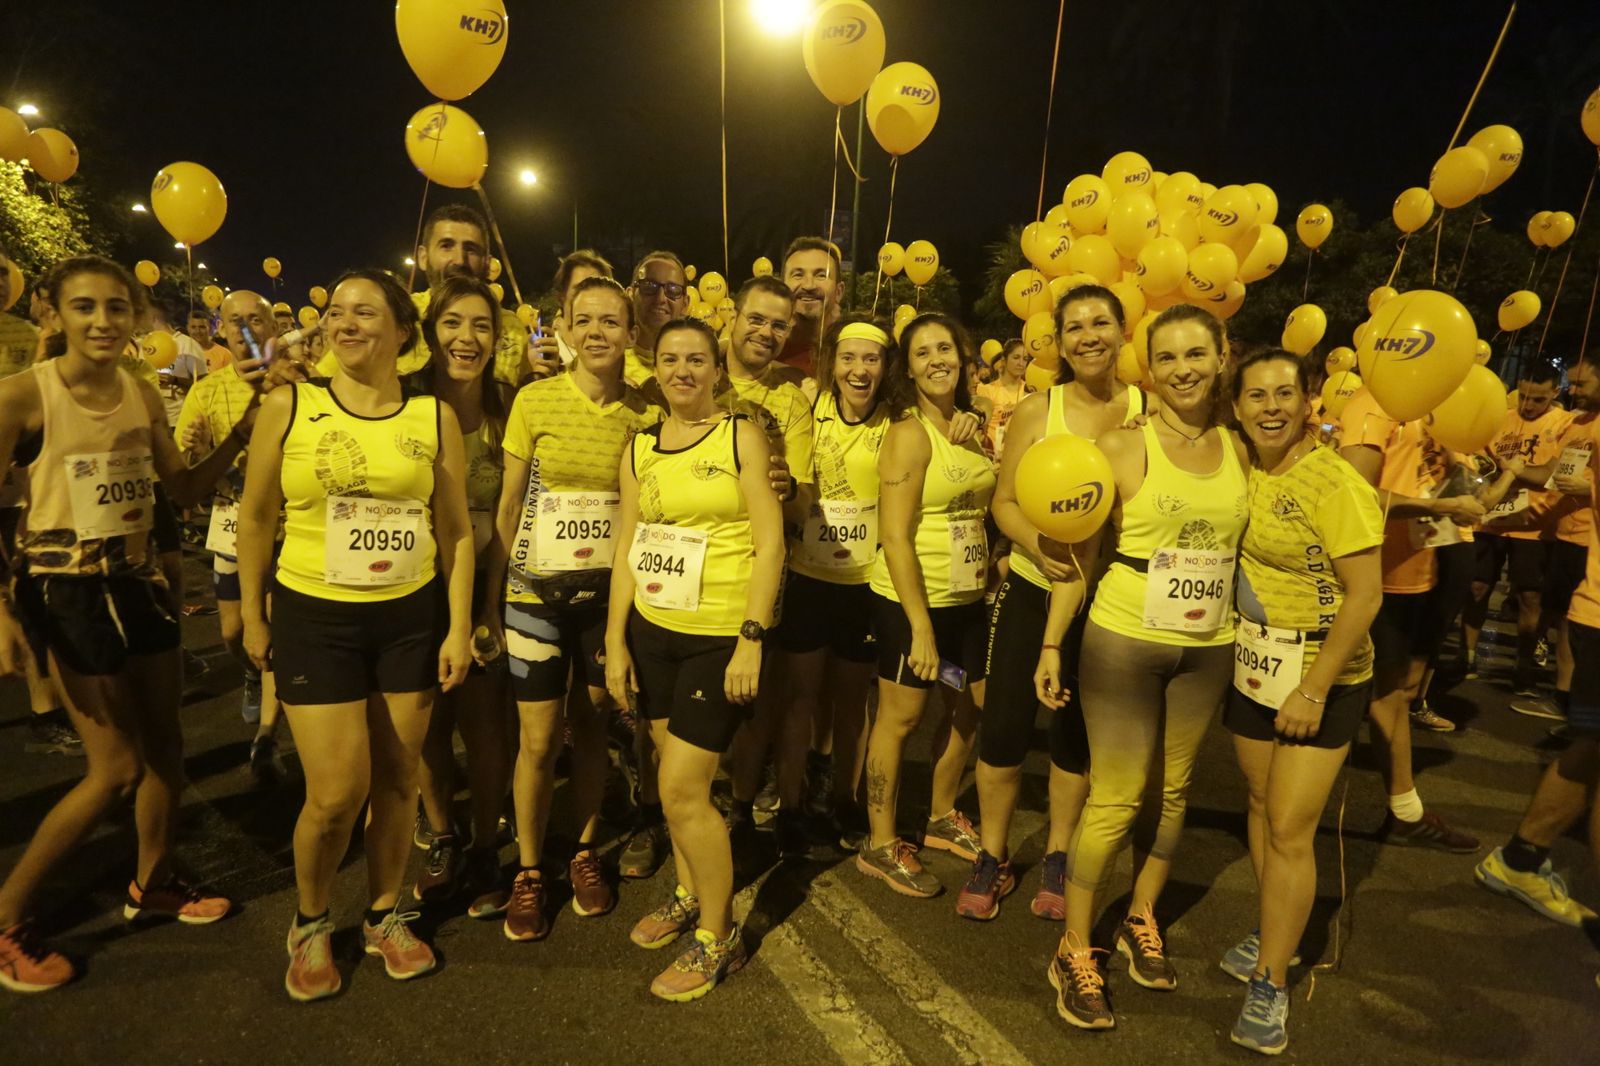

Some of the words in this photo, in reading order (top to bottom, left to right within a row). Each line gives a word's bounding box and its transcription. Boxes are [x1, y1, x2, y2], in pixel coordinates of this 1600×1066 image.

[349, 528, 415, 551] 20950
[555, 519, 611, 540] 20952
[818, 523, 867, 543] 20940
[637, 551, 685, 577] 20944
[1168, 578, 1224, 600] 20946
[1236, 643, 1283, 678] 20947
